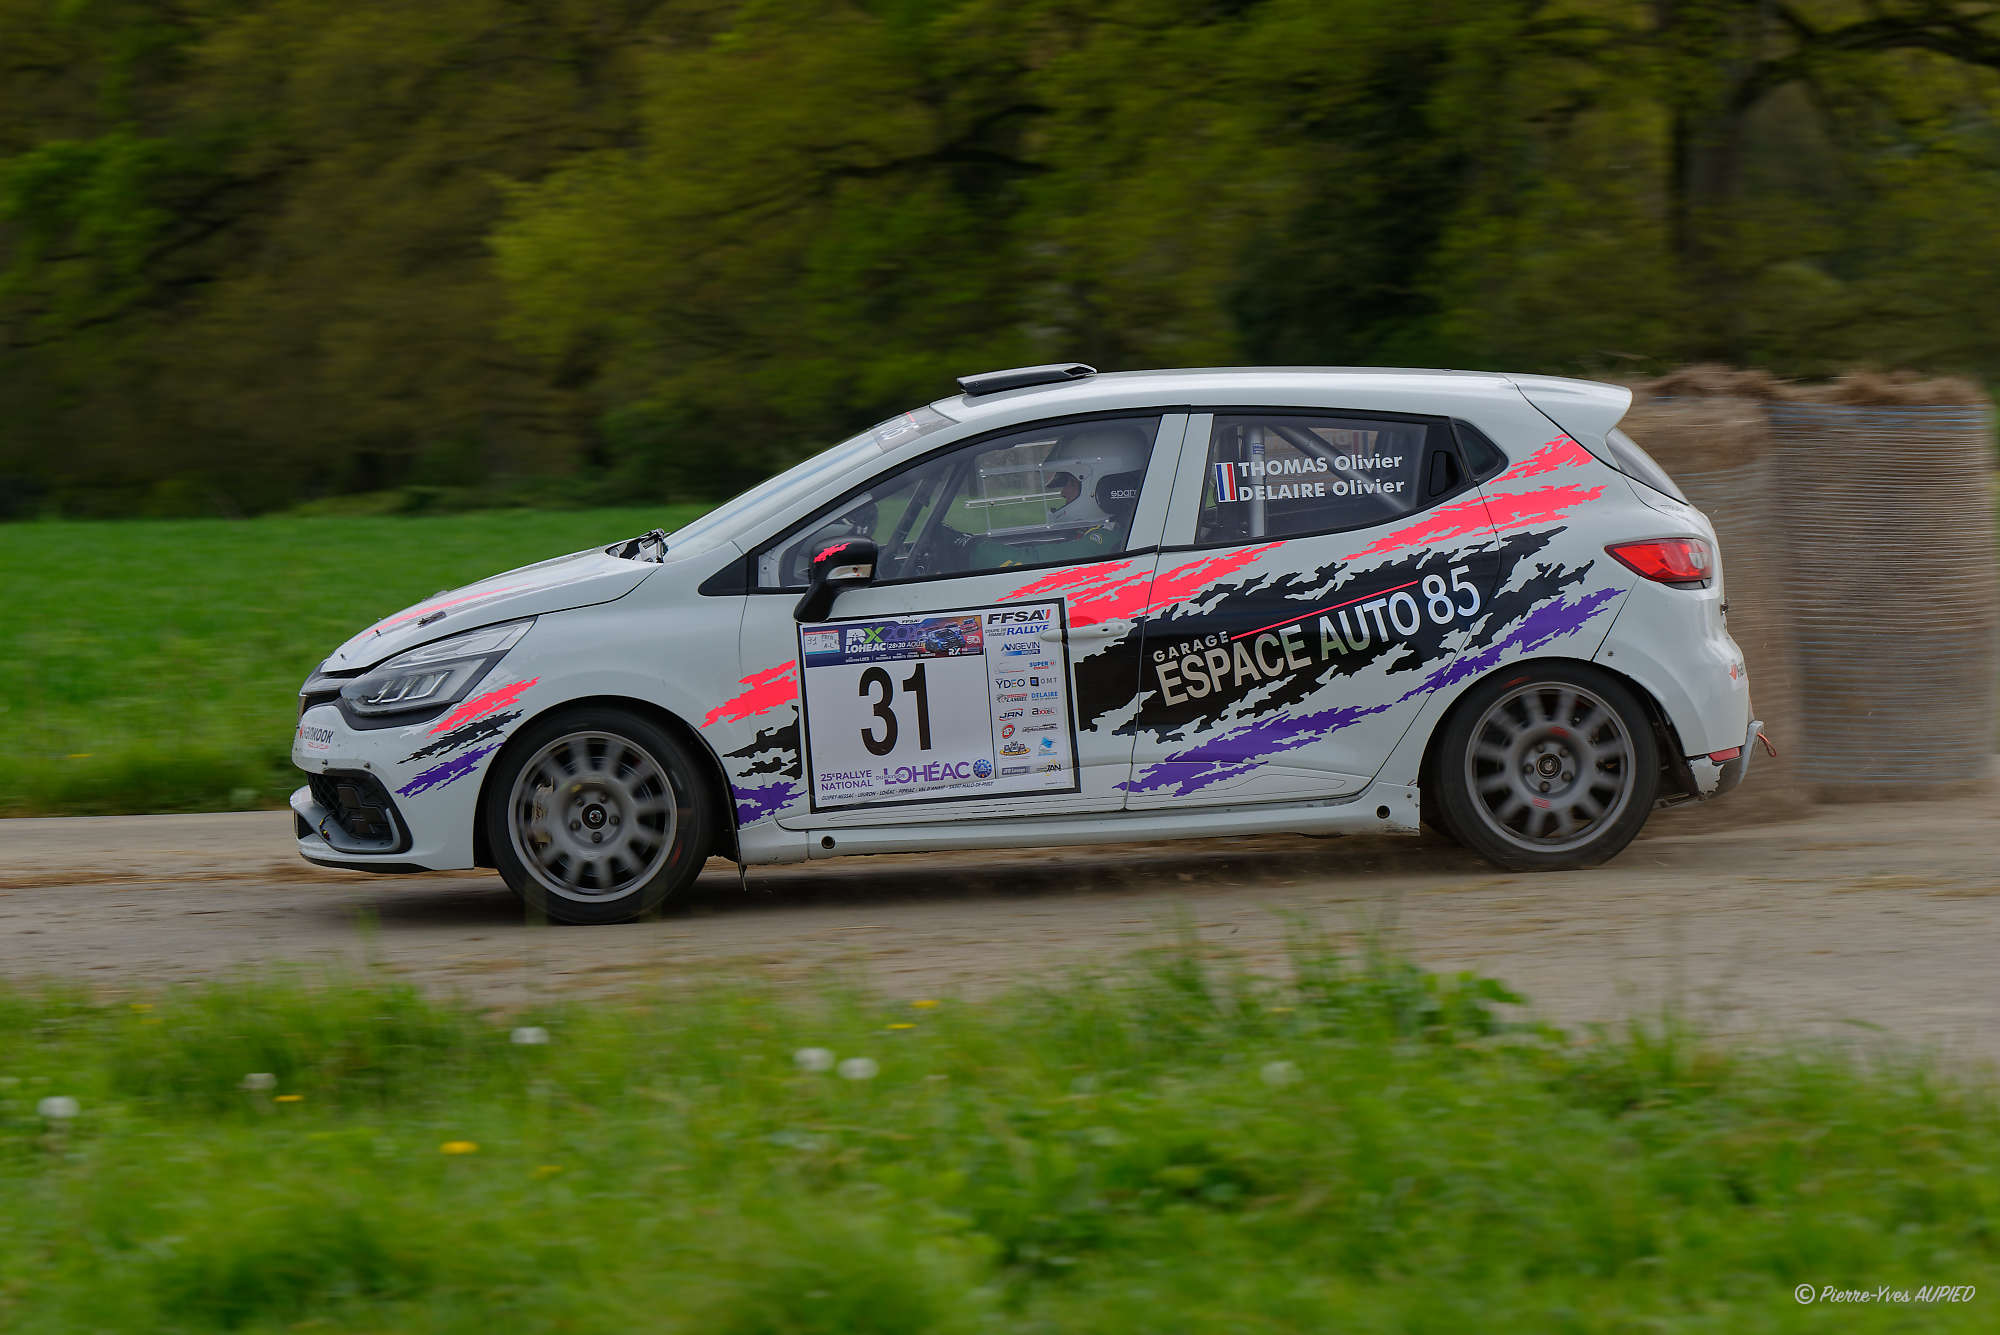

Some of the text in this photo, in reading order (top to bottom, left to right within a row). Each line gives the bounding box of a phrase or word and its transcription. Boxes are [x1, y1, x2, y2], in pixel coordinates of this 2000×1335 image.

[1238, 453, 1403, 477] THOMAS Olivier
[1238, 478, 1405, 502] DELAIRE Olivier
[987, 609, 1045, 624] FFSA
[846, 626, 885, 645] RX
[1155, 565, 1481, 706] ESPACE AUTO 85
[845, 642, 887, 654] LOHEAC
[1001, 641, 1040, 652] ANGEVIN
[1153, 631, 1230, 663] GARAGE
[995, 678, 1026, 689] YDEO
[858, 663, 932, 756] 31
[835, 769, 872, 781] RALLYE
[883, 760, 971, 785] LOHÉAC
[821, 779, 873, 791] NATIONAL
